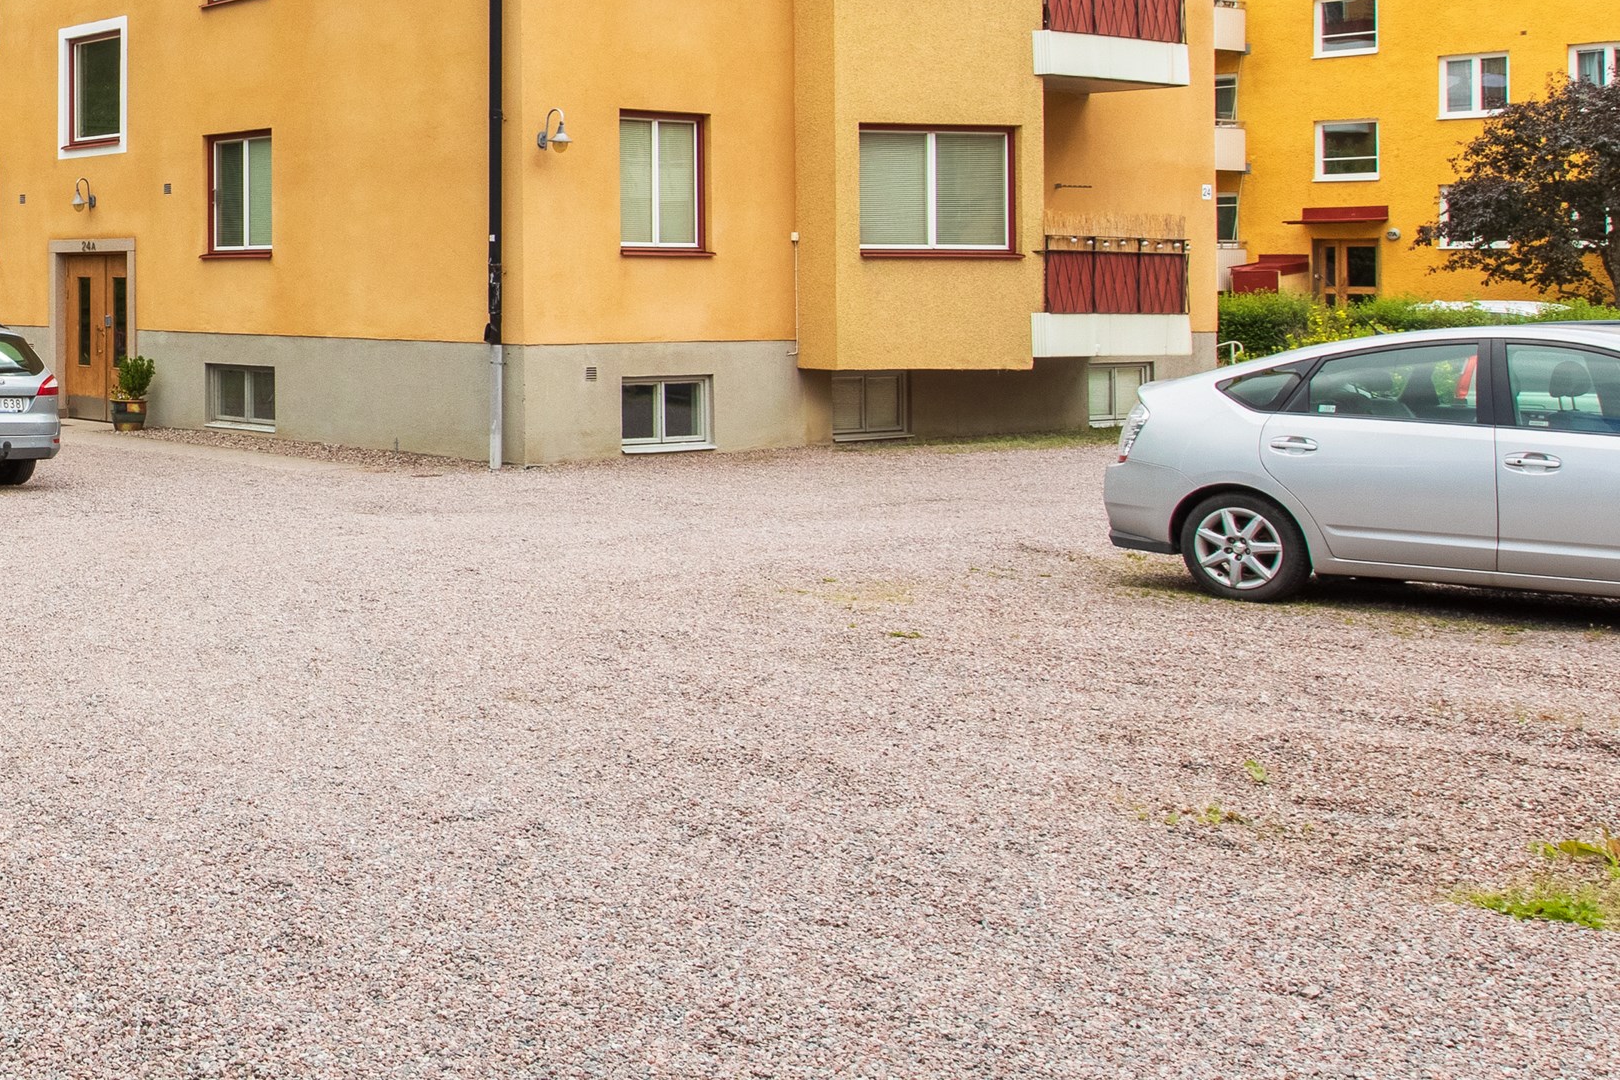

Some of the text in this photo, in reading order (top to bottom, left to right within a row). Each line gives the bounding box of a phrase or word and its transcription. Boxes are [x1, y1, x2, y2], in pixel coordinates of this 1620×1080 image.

[1202, 187, 1211, 197] 24
[81, 241, 96, 252] 24A
[3, 399, 21, 409] 638
